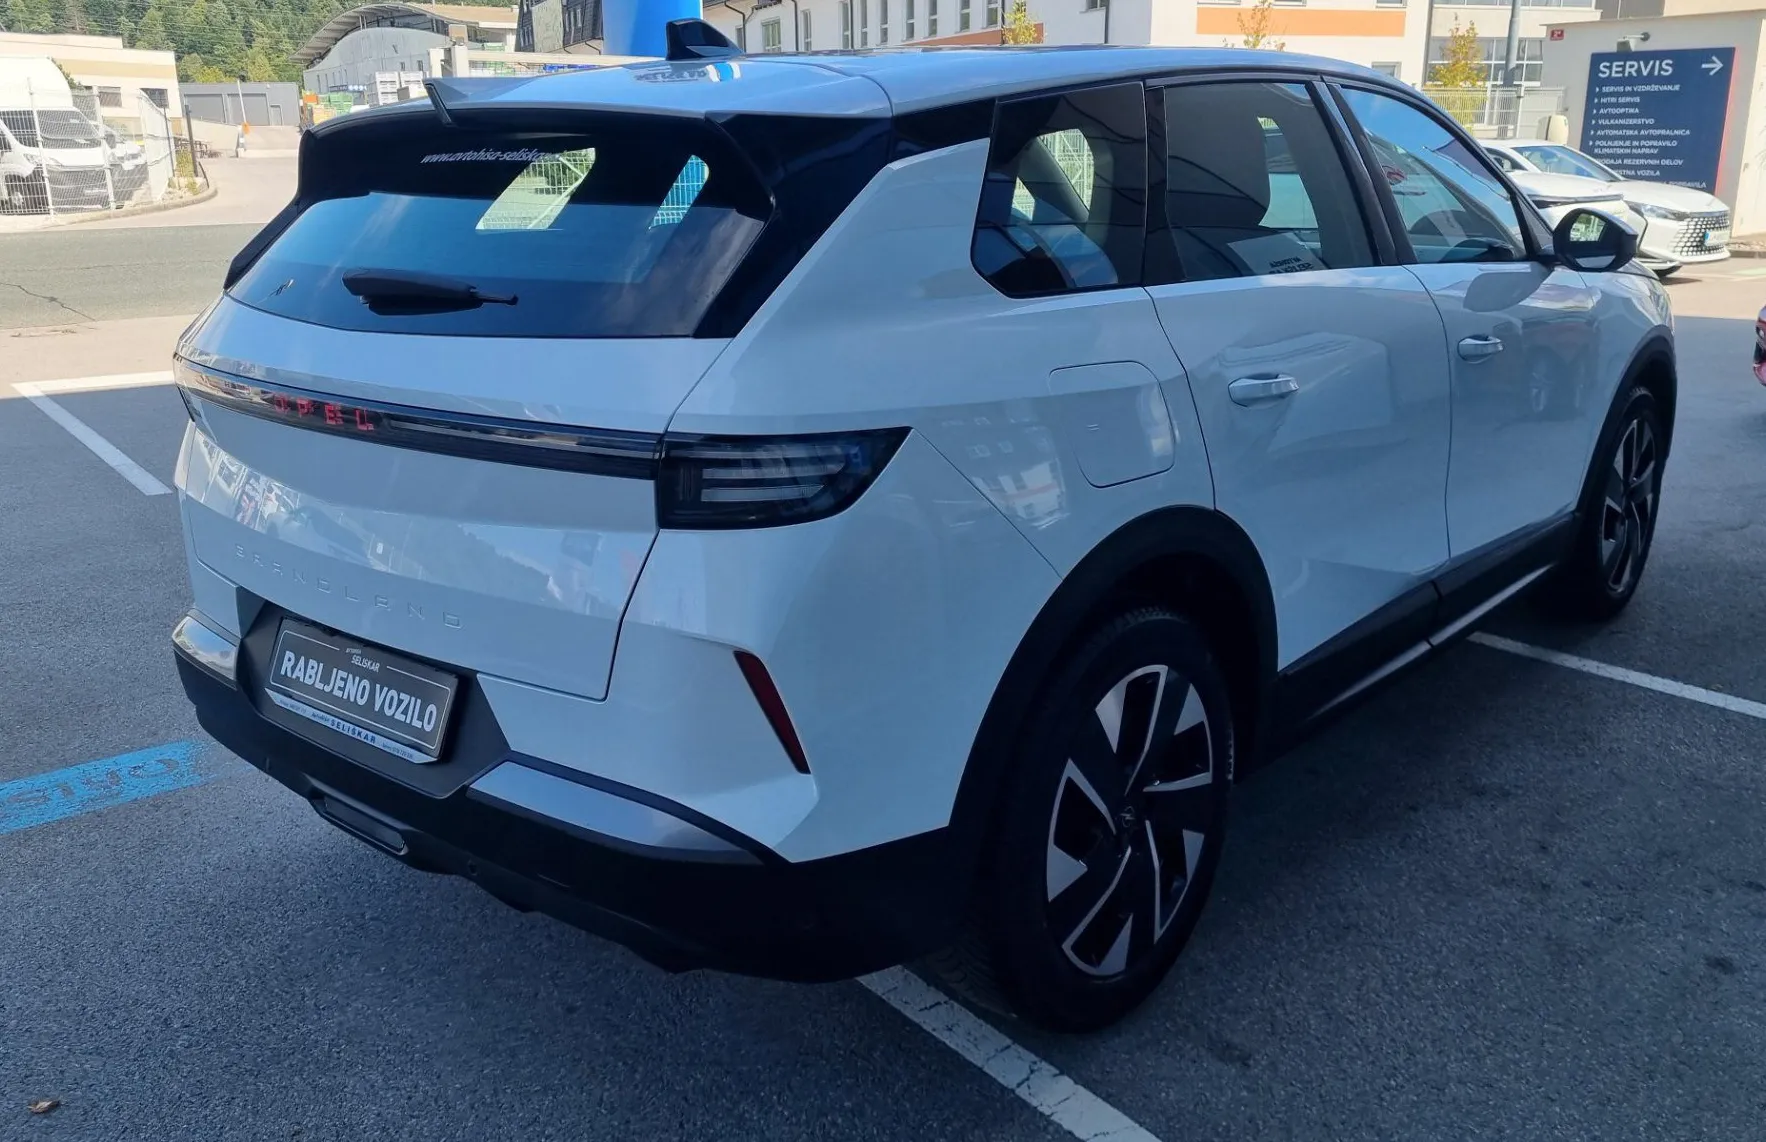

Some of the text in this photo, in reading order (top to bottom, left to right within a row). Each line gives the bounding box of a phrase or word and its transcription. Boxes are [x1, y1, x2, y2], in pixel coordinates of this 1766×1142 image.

[1598, 59, 1673, 78] SERVIS
[1633, 84, 1681, 92] VZDRŽEVANJE
[274, 393, 375, 431] OPEL
[280, 650, 437, 732] RABLJENO VOZILO
